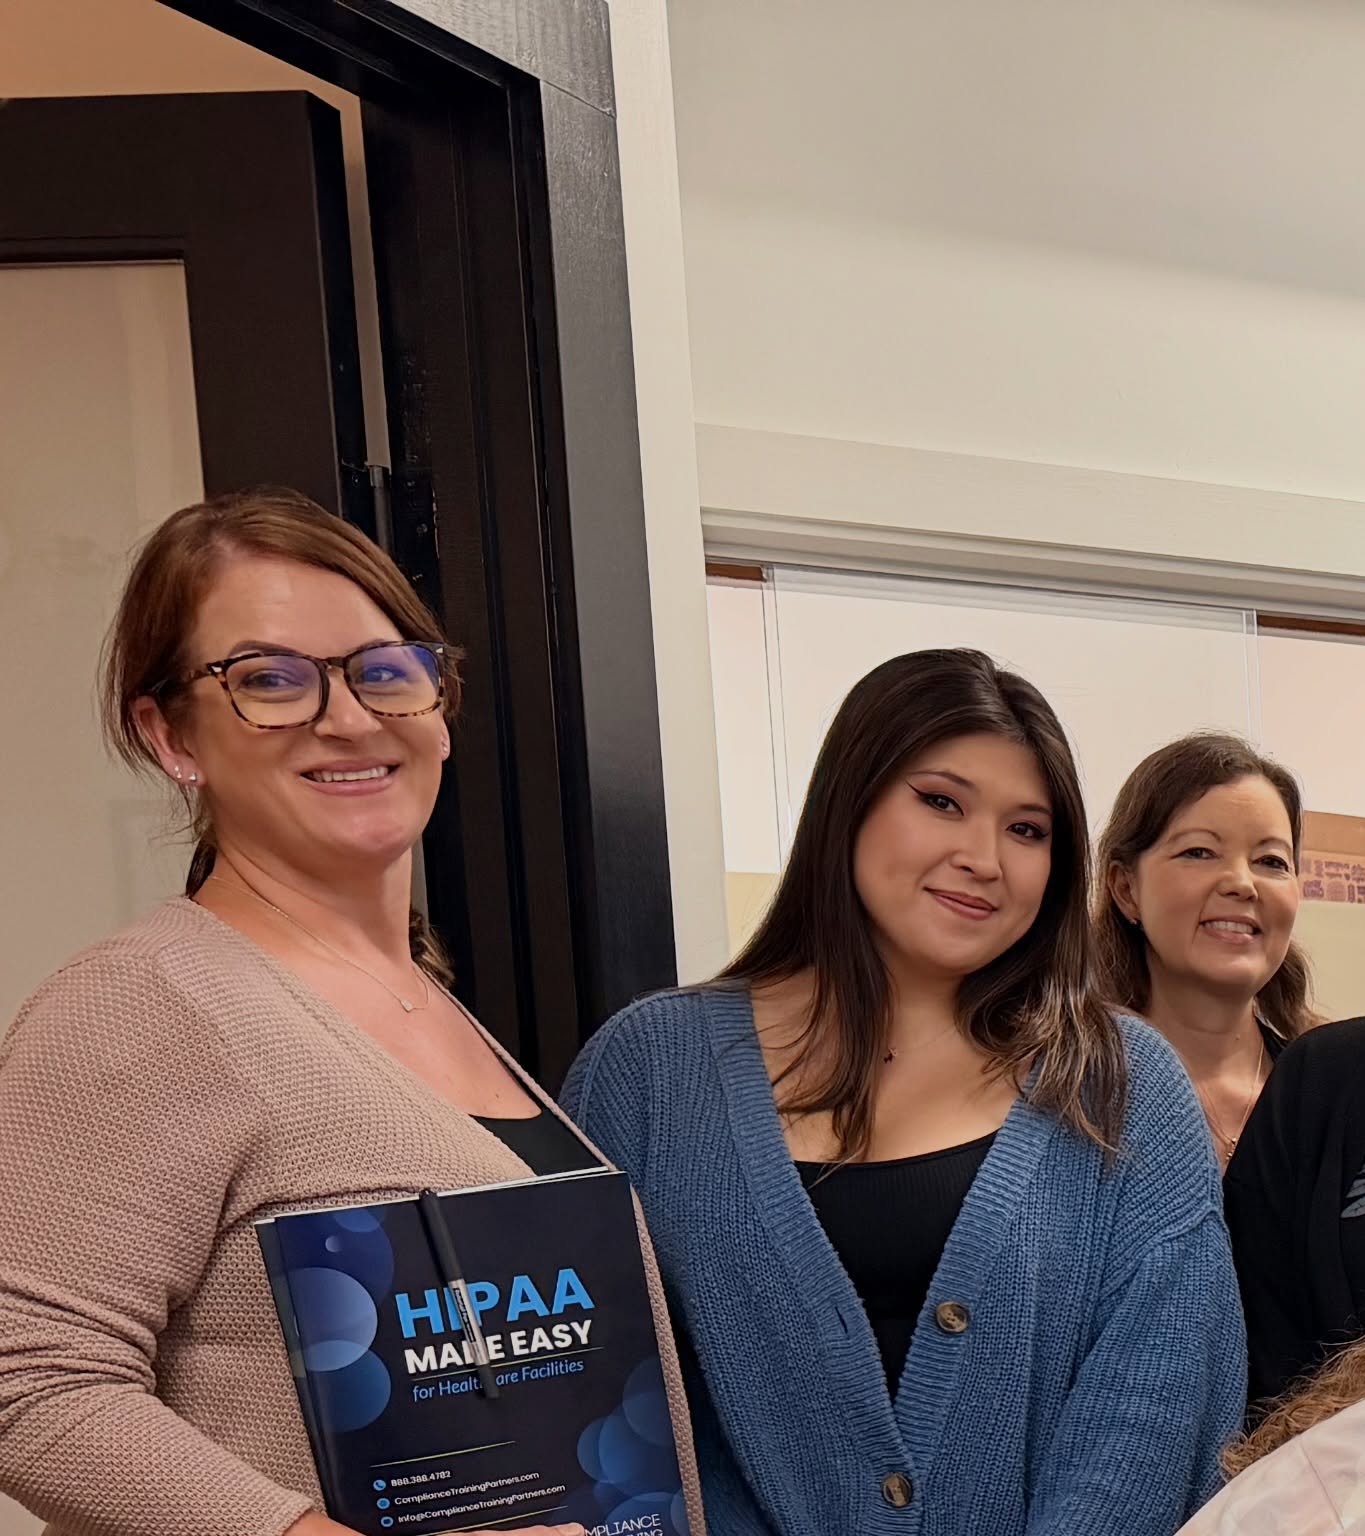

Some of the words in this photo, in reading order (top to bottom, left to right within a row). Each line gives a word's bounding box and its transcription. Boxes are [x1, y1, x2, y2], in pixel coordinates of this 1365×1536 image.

[395, 1268, 596, 1339] HIPAA
[510, 1319, 592, 1356] EASY
[412, 1385, 435, 1402] for
[439, 1371, 519, 1396] Healtare
[521, 1360, 584, 1382] Facilities
[394, 1471, 540, 1505] ComplianceTrainingPartners.com
